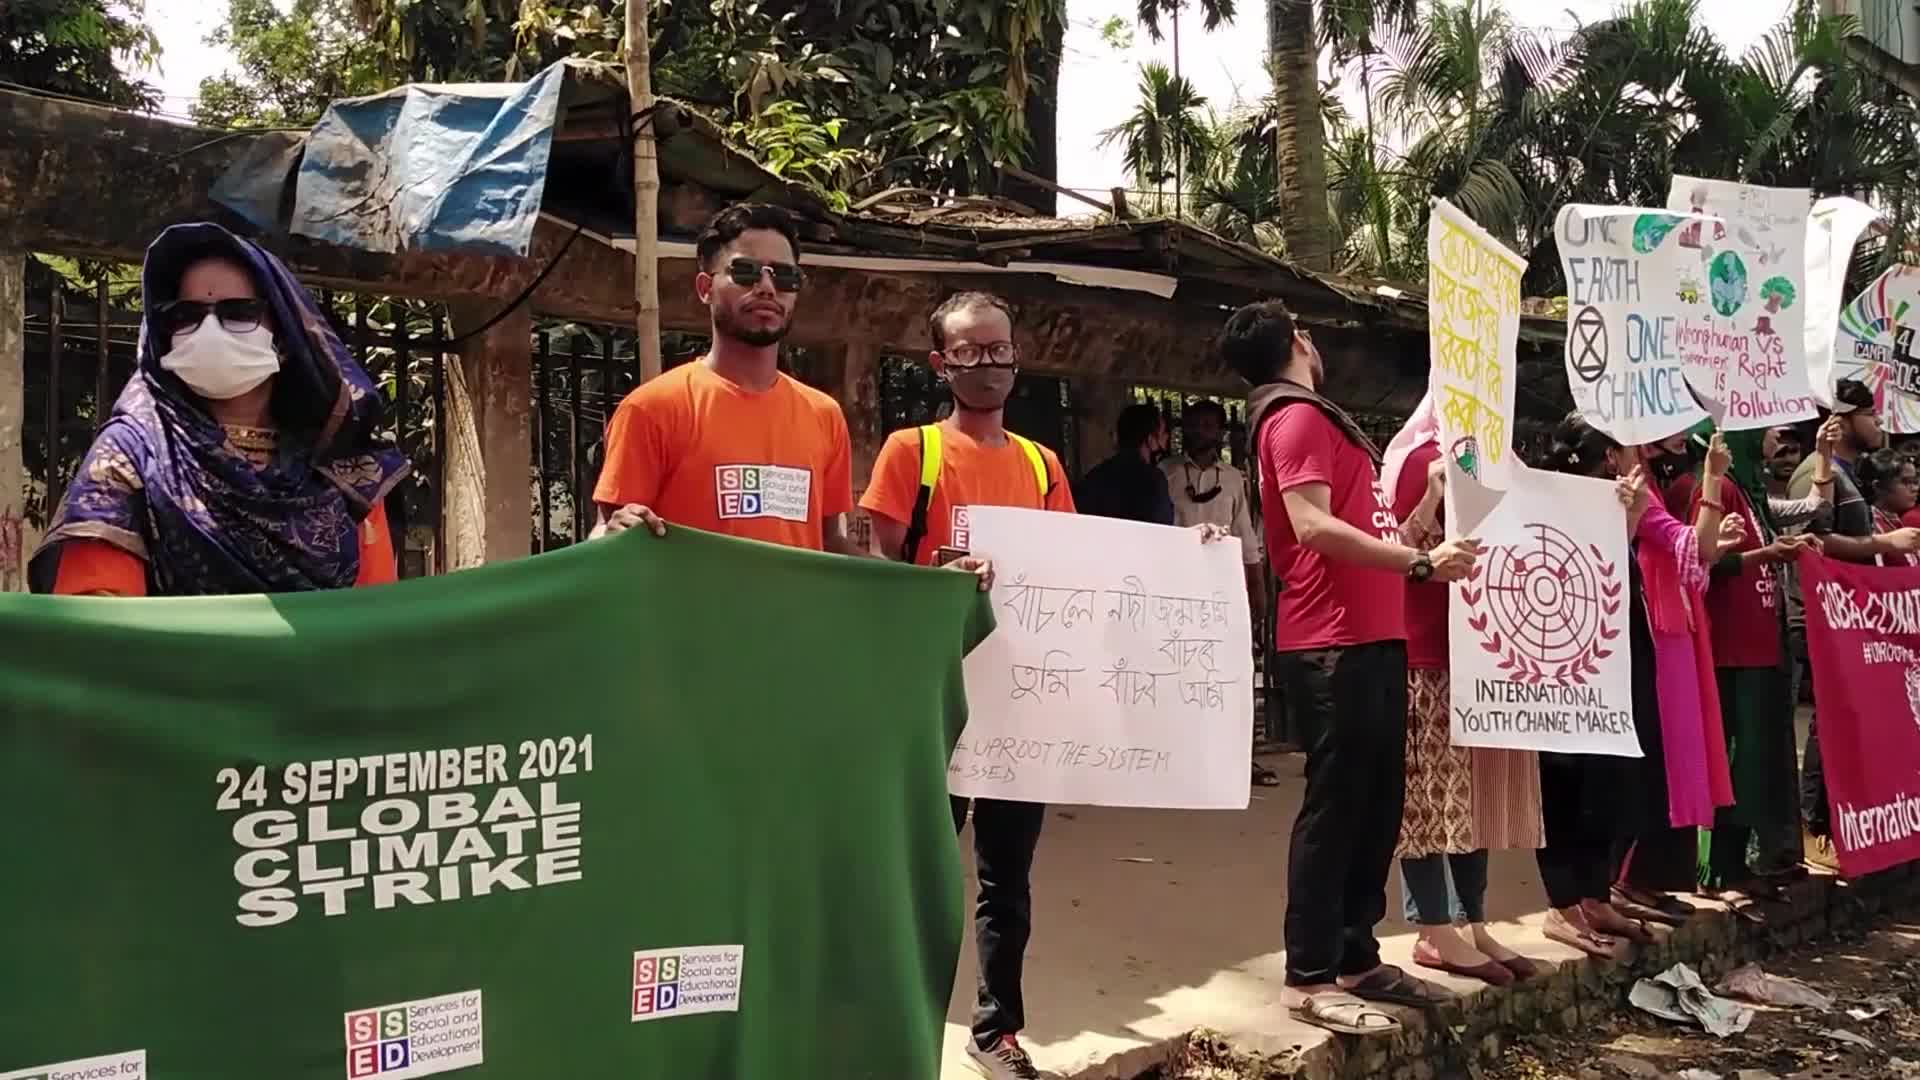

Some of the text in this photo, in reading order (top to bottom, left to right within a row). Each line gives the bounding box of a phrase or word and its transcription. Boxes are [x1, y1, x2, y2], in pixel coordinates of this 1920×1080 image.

[1569, 256, 1640, 306] EARTH
[1626, 313, 1675, 363] ONE
[1897, 330, 1911, 354] 4
[1738, 352, 1787, 390] Right
[1596, 367, 1693, 423] CHANCE
[1729, 390, 1818, 419] Pollution
[1104, 575, 1147, 632] নদী
[1010, 649, 1086, 704] তুমি
[1475, 678, 1608, 709] INTERNATIONAL
[1456, 707, 1632, 734] YOUTH CHANGE MAKER
[1056, 740, 1090, 768] THE
[1090, 744, 1171, 773] SYSTEM
[216, 734, 592, 810] 24 SEPTEMBER 2021
[232, 782, 581, 848] GLOBAL
[234, 813, 581, 887] CLIMATE
[236, 849, 582, 926] STRIKE
[680, 966, 736, 978] Social and
[682, 952, 739, 965] Services for
[679, 992, 736, 1006] Development
[680, 979, 737, 992] Educational
[410, 996, 479, 1018] Services for
[410, 1010, 479, 1033] Social and
[411, 1024, 480, 1048] Educational
[411, 1040, 481, 1063] Development
[51, 1060, 142, 1080] Services for
